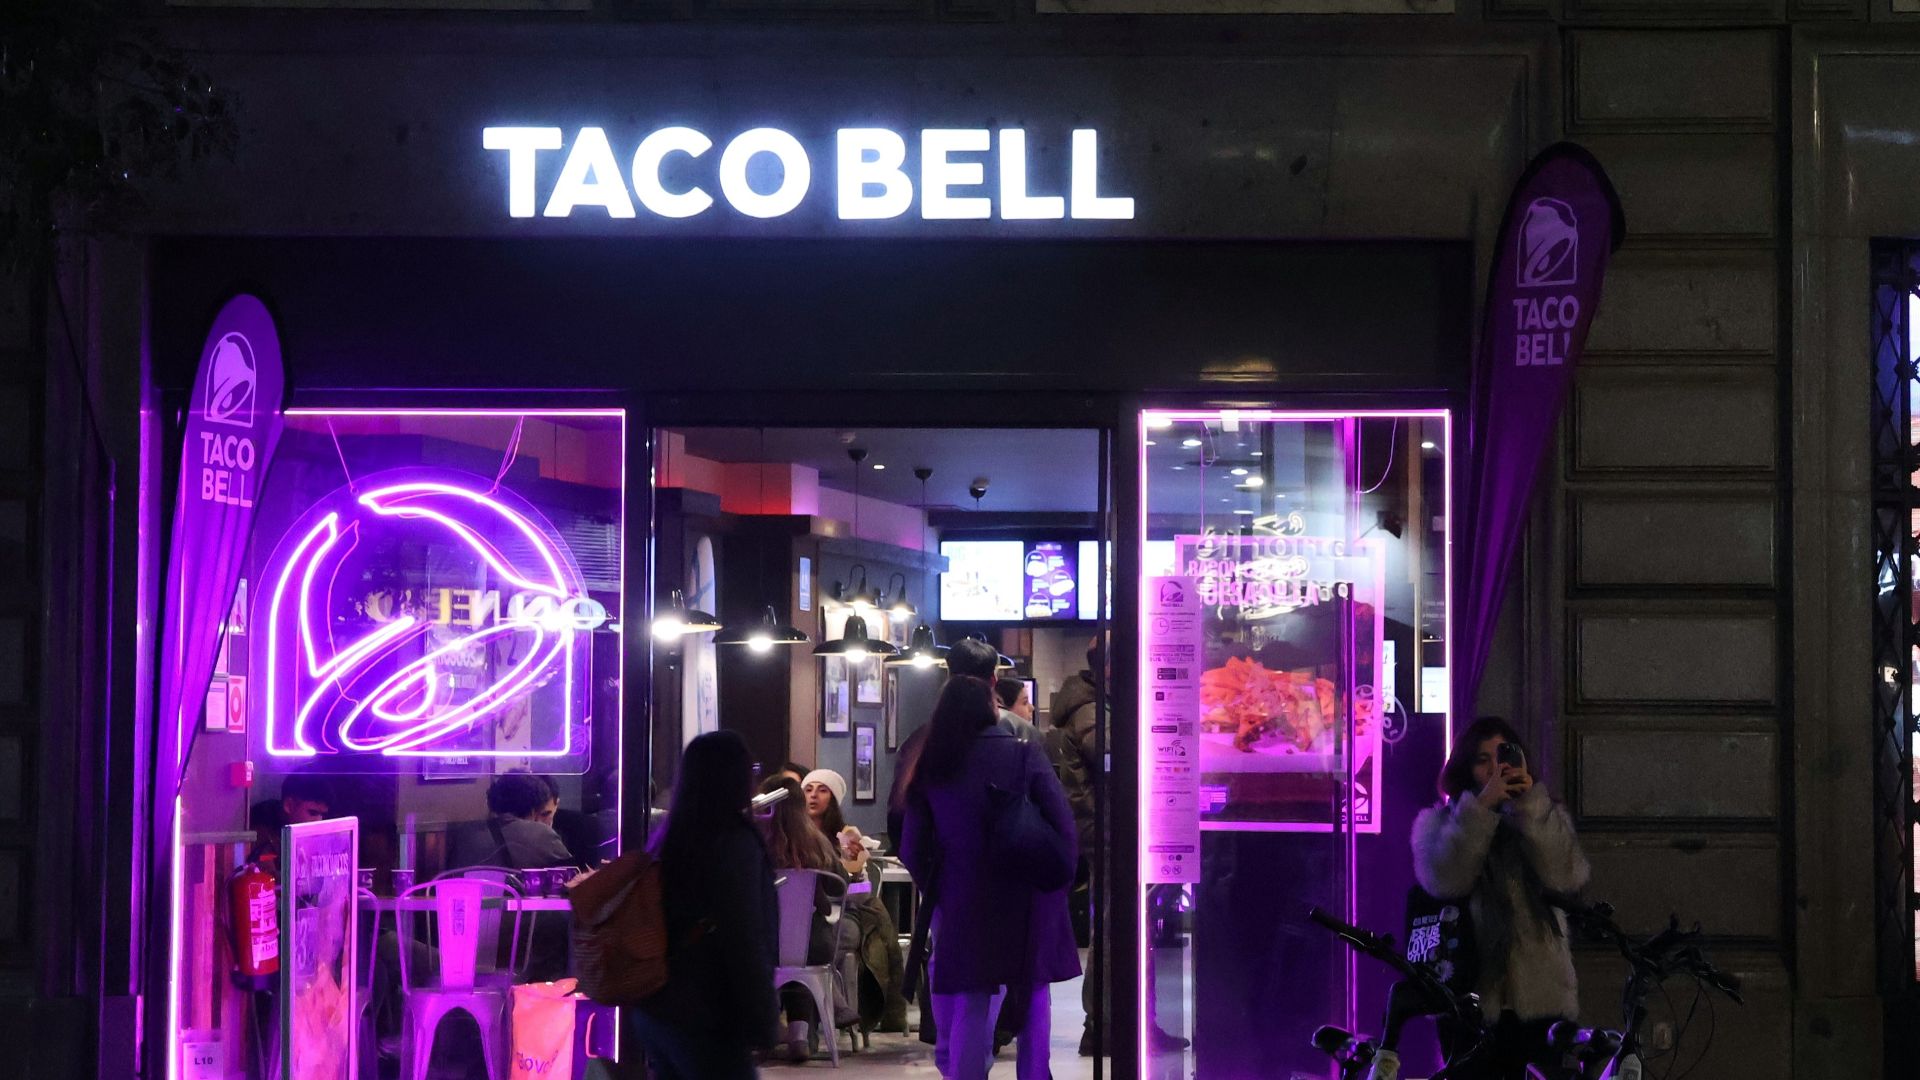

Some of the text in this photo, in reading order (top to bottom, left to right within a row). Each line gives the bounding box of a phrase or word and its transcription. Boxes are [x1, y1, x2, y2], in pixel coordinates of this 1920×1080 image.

[483, 126, 1135, 219] TACO BELL
[1513, 295, 1579, 330] TACO
[201, 432, 255, 471] TACO
[202, 468, 253, 508] BELL
[194, 1056, 214, 1065] L10
